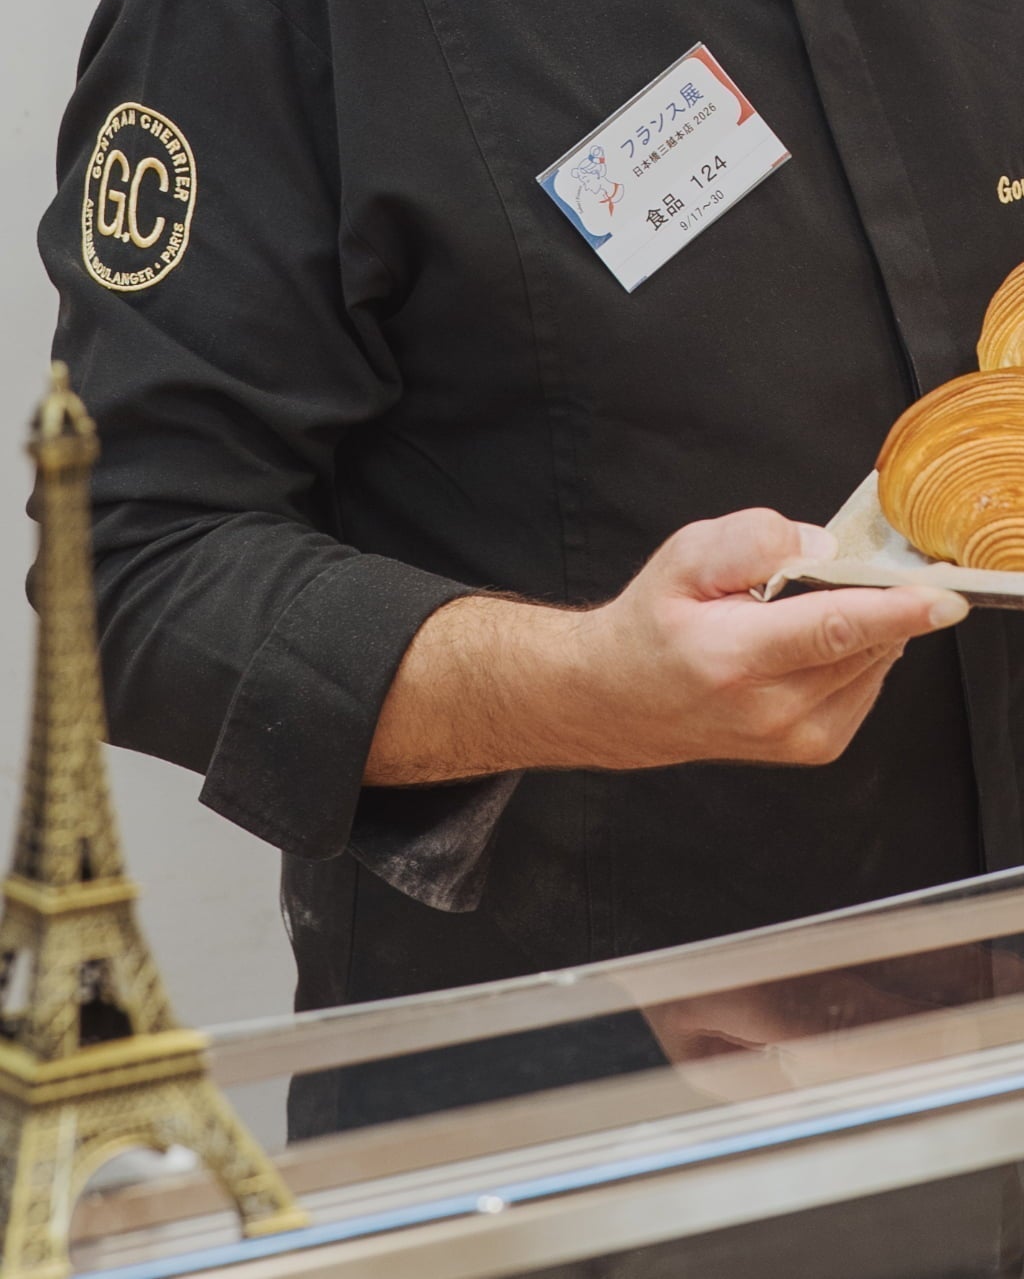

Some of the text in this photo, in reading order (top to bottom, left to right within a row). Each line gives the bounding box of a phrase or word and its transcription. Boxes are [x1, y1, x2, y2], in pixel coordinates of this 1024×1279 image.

[92, 110, 191, 202] GONTRAN CHERRIER
[620, 82, 704, 159] フランス展
[632, 102, 718, 178] 日本橋三越本店 2026
[645, 154, 728, 232] 食品 124
[91, 256, 155, 286] BOULANGER
[159, 222, 185, 263] PARIS
